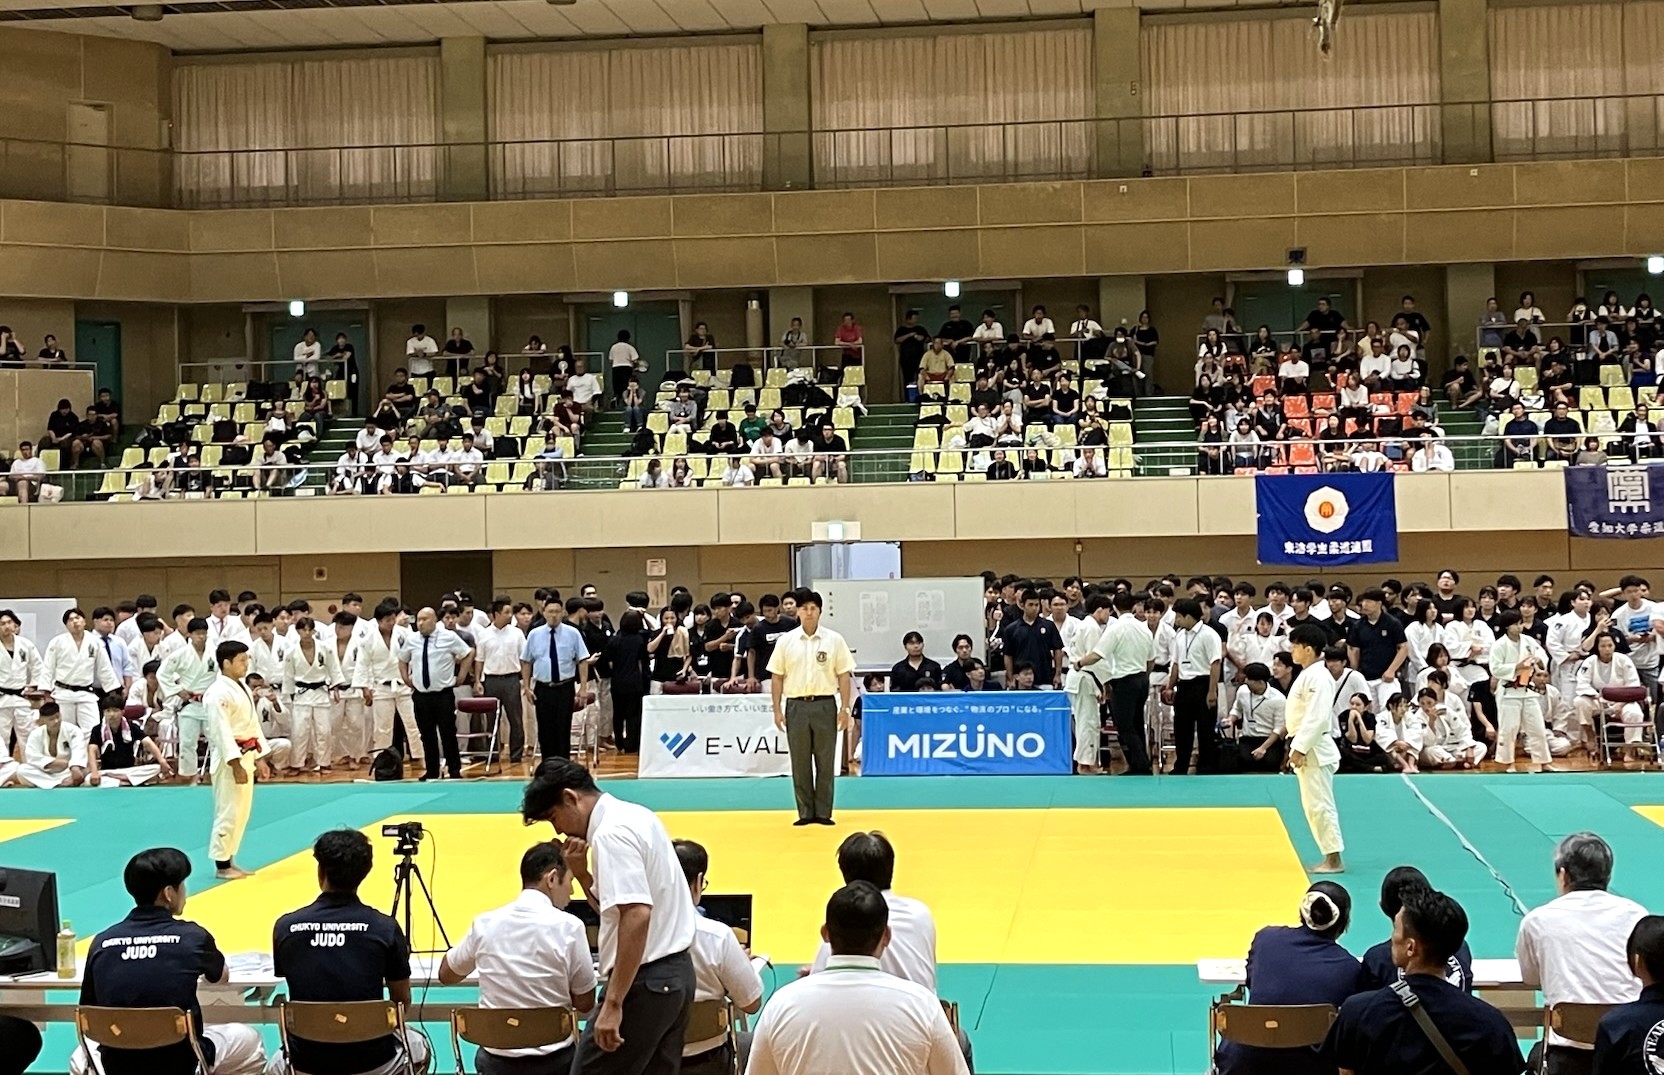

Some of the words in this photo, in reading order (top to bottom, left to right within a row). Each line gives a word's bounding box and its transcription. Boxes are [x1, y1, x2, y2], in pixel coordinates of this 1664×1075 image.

[705, 735, 789, 756] E-VAL
[321, 922, 369, 932] UNIVERSITY
[132, 934, 181, 945] UNIVERSITY
[310, 932, 346, 947] JUDO
[121, 945, 157, 960] JUDO
